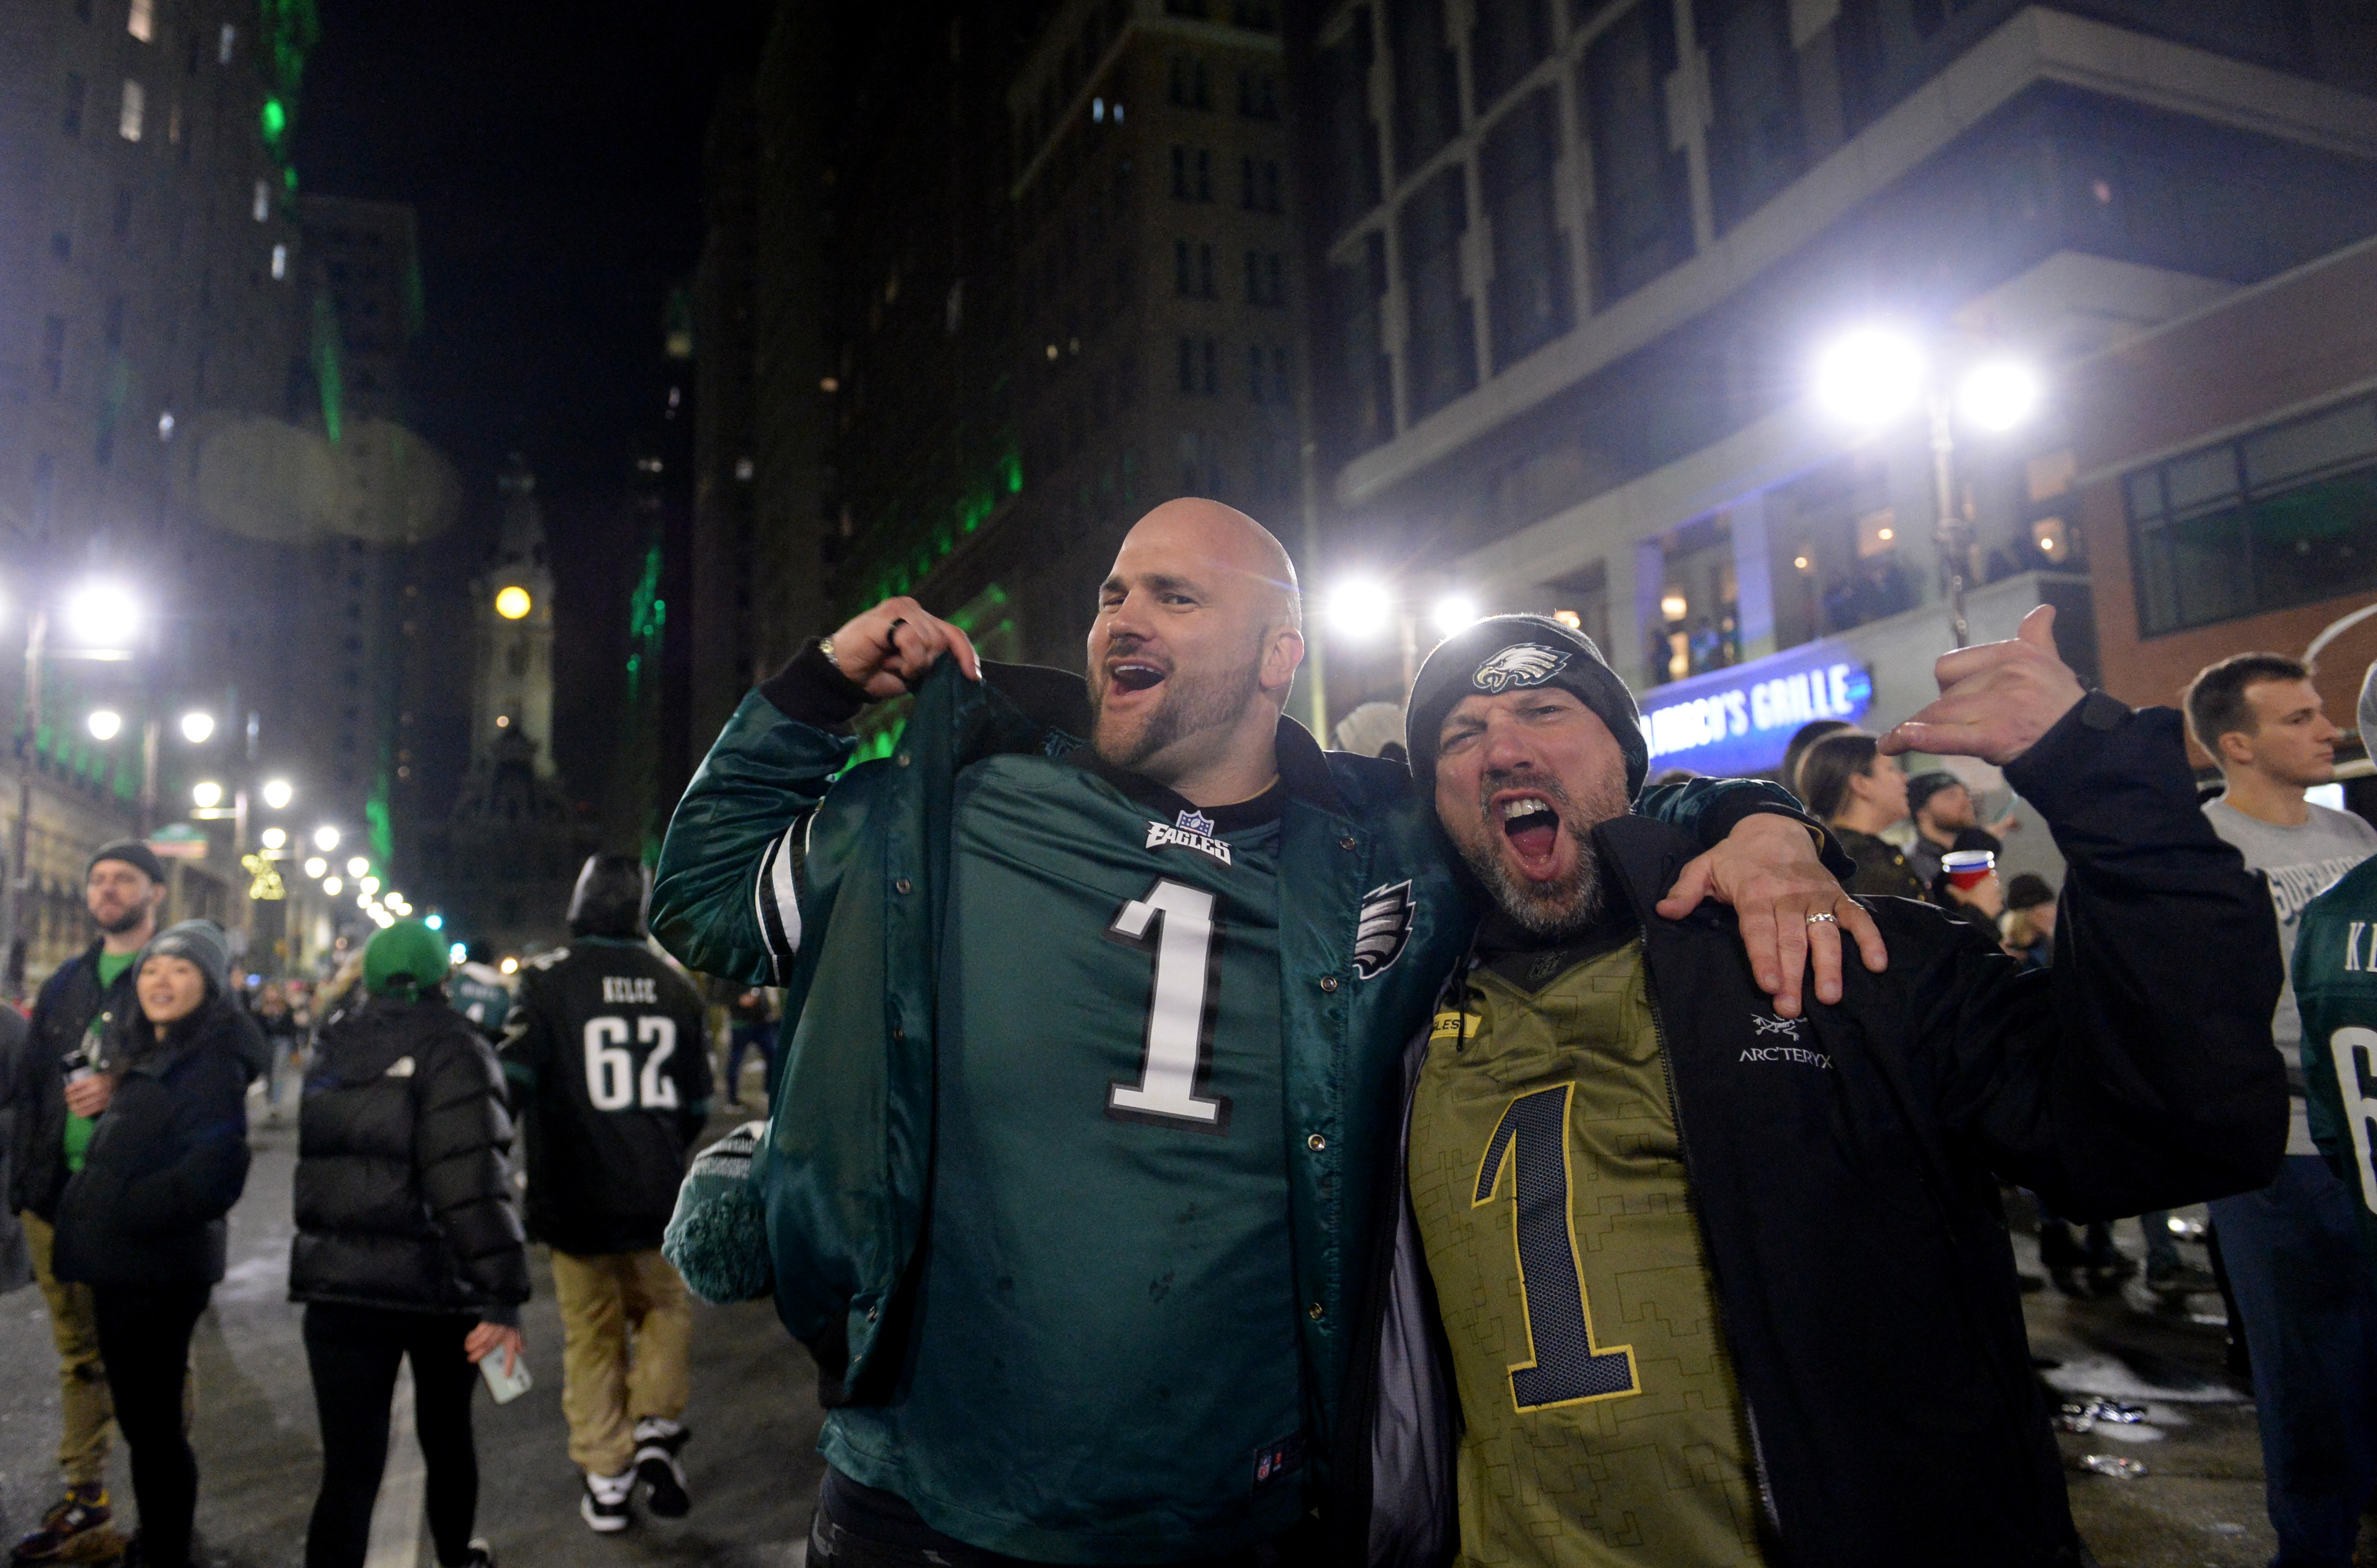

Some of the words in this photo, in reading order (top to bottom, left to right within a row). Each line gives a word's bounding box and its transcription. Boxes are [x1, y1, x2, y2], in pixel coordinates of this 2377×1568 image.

[1751, 664, 1854, 731] GRILLE
[1146, 821, 1231, 866] EAGLES
[1108, 877, 1221, 1125] 1
[584, 1015, 678, 1112] 62
[1739, 1047, 1834, 1069] ARC'TERYX
[1471, 1081, 1642, 1414] 1
